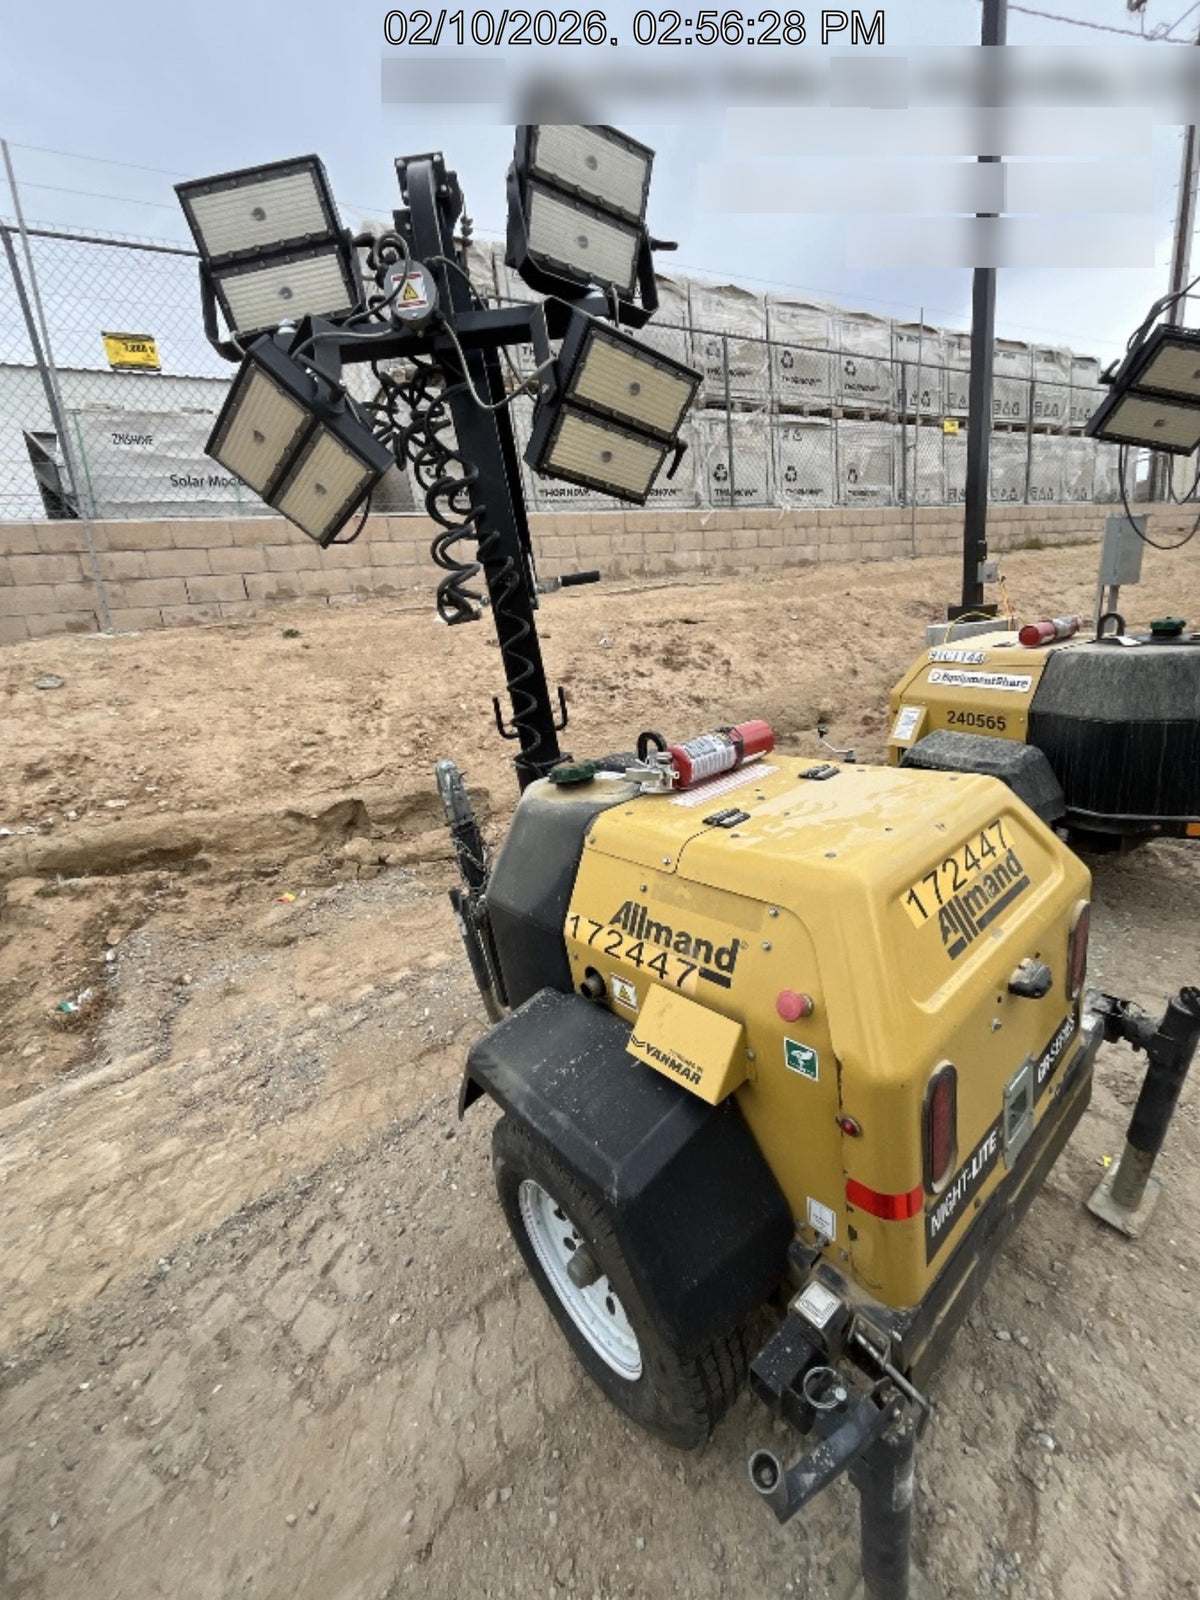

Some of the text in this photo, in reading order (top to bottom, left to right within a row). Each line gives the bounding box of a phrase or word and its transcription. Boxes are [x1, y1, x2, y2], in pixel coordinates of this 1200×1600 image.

[170, 474, 204, 487] Solar
[947, 710, 1006, 732] 240565
[905, 818, 1007, 920] 172447
[938, 847, 1023, 946] Allmand
[569, 914, 697, 988] 172447
[609, 900, 740, 975] Allmand
[646, 1043, 701, 1085] YANMAR
[930, 1127, 997, 1238] NIGHT-LITE
